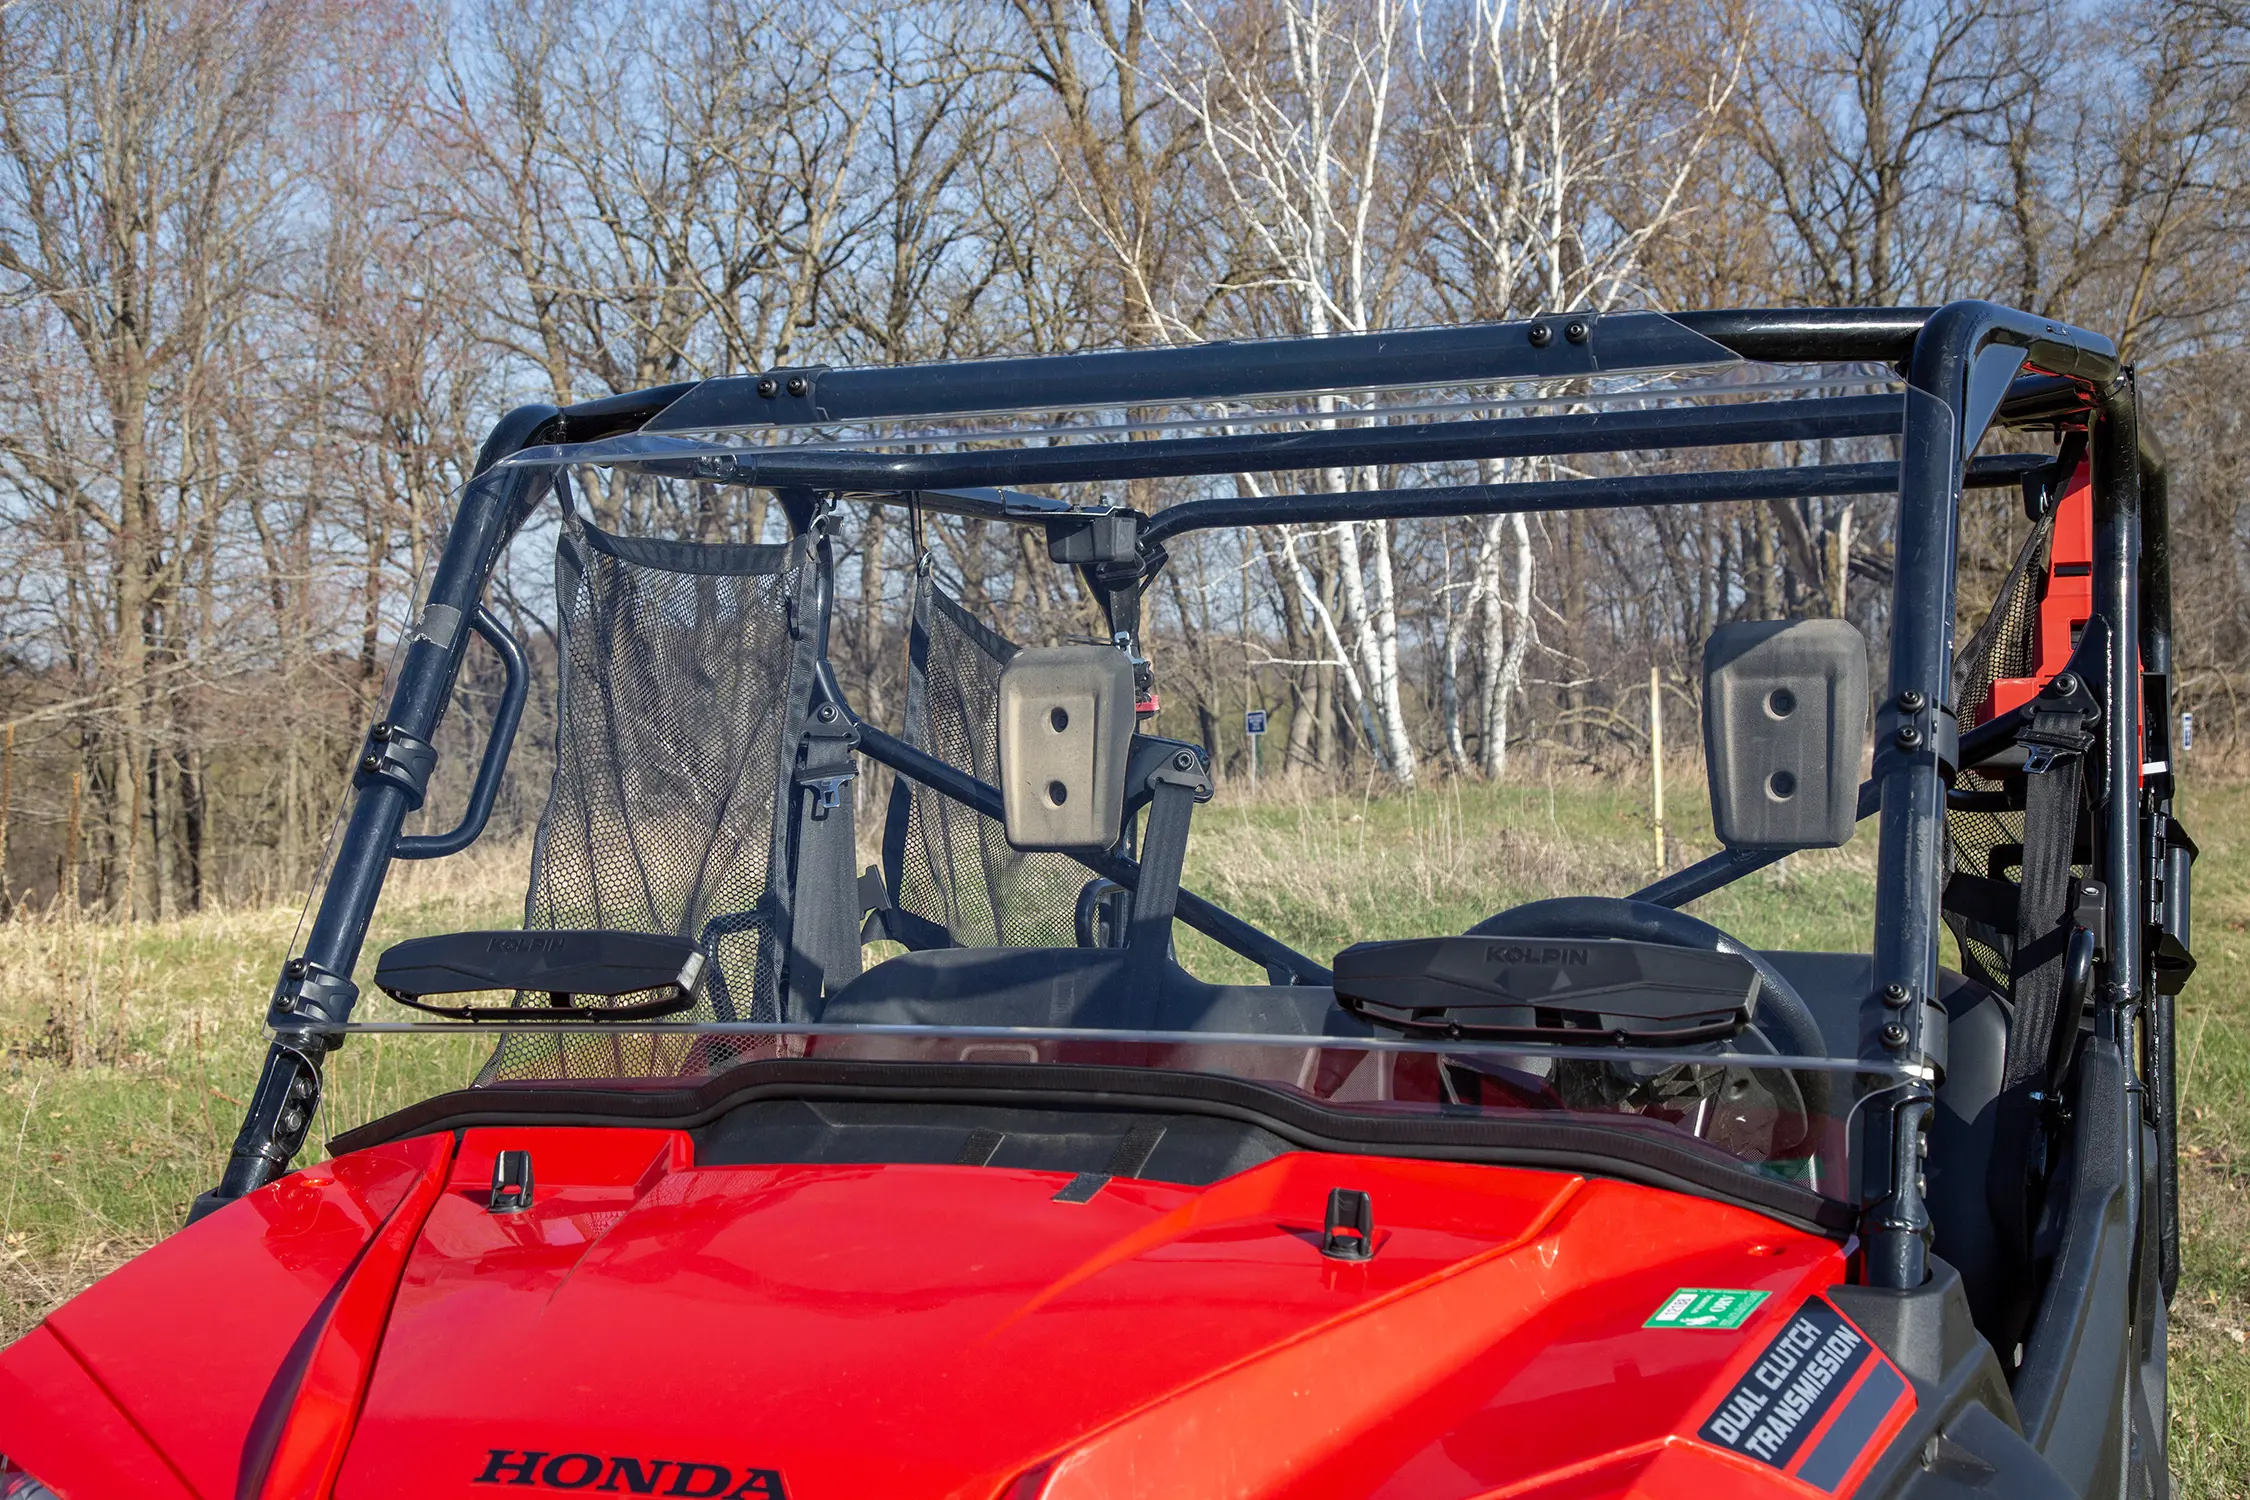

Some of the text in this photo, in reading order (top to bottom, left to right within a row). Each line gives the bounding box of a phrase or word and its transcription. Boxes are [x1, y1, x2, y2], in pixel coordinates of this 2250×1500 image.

[487, 937, 565, 952] KOLPIN
[1484, 945, 1590, 966] KOLPIN
[1710, 1386, 1769, 1445] DUAL
[1755, 1316, 1822, 1391] CLUTCH
[1744, 1324, 1862, 1461] TRANSMISSION
[473, 1449, 789, 1500] HONDA
